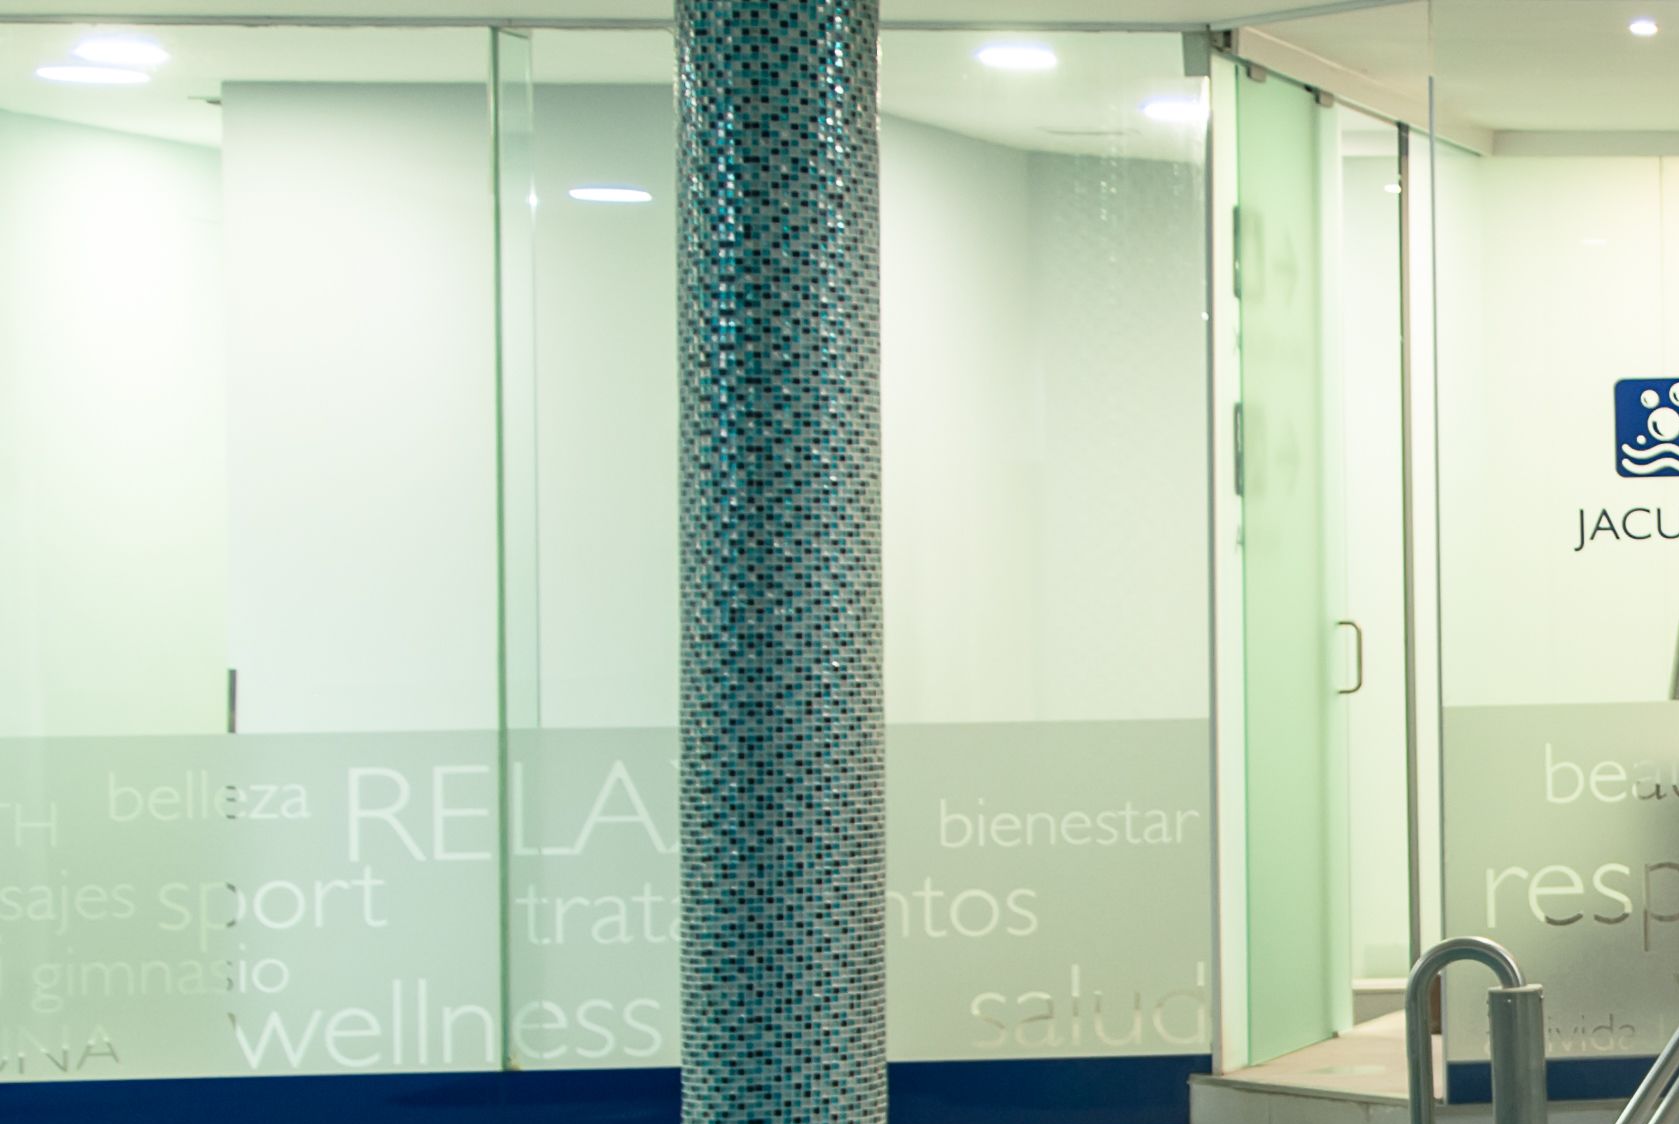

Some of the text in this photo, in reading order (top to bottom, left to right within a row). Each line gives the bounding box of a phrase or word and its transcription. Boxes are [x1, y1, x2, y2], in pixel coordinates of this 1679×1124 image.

[108, 769, 311, 822] belleza
[348, 759, 682, 862] RELA
[939, 797, 1199, 848] bienestar
[157, 864, 389, 952] sport
[31, 941, 290, 1013] gimnasio
[970, 961, 1210, 1048] salud
[227, 978, 663, 1069] wellness
